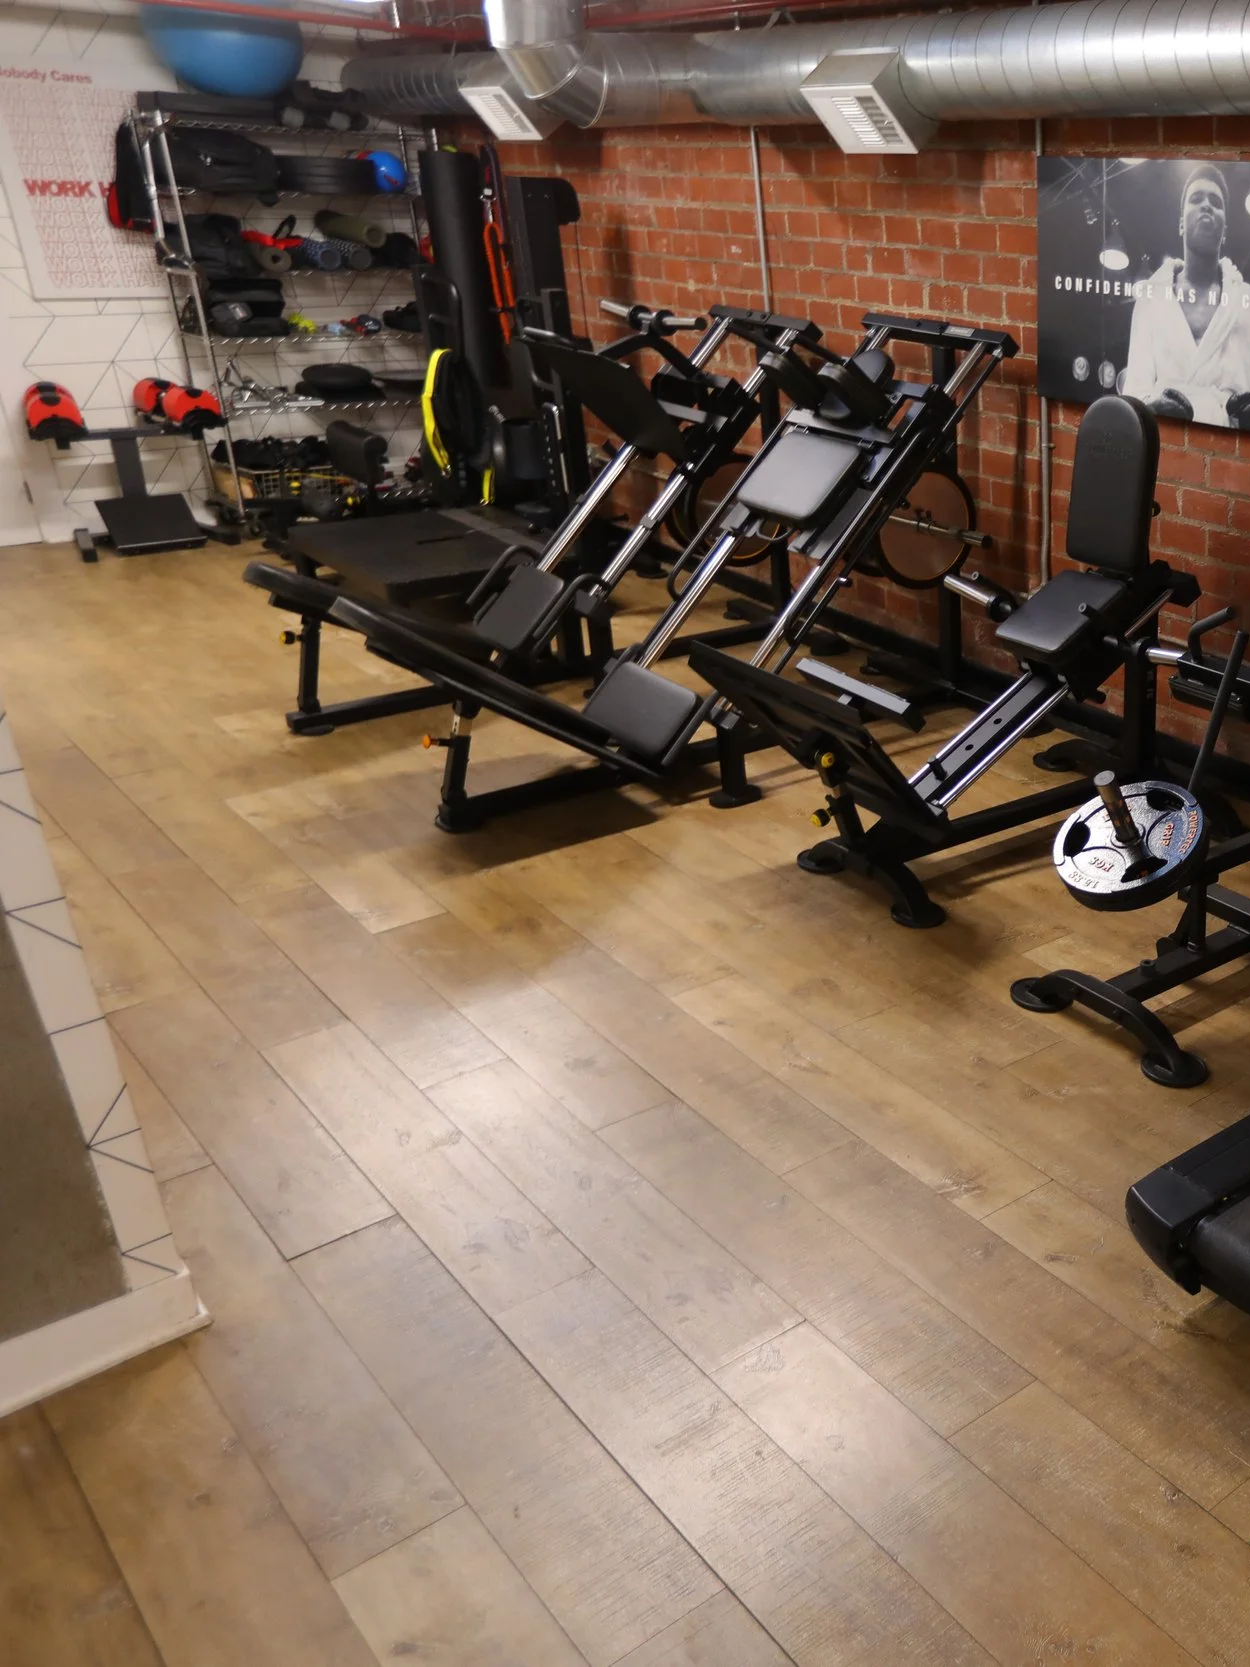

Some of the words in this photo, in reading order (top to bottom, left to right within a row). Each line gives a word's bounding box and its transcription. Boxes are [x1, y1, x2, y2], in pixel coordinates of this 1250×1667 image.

[0, 68, 46, 83] obody
[50, 69, 93, 84] Cares
[23, 178, 97, 198] WORK
[1054, 275, 1153, 298] CONFIDENCE
[1165, 286, 1196, 303] HAS
[1208, 290, 1229, 306] NO
[1161, 822, 1175, 847] GRIP
[1178, 810, 1198, 854] POWERTEC
